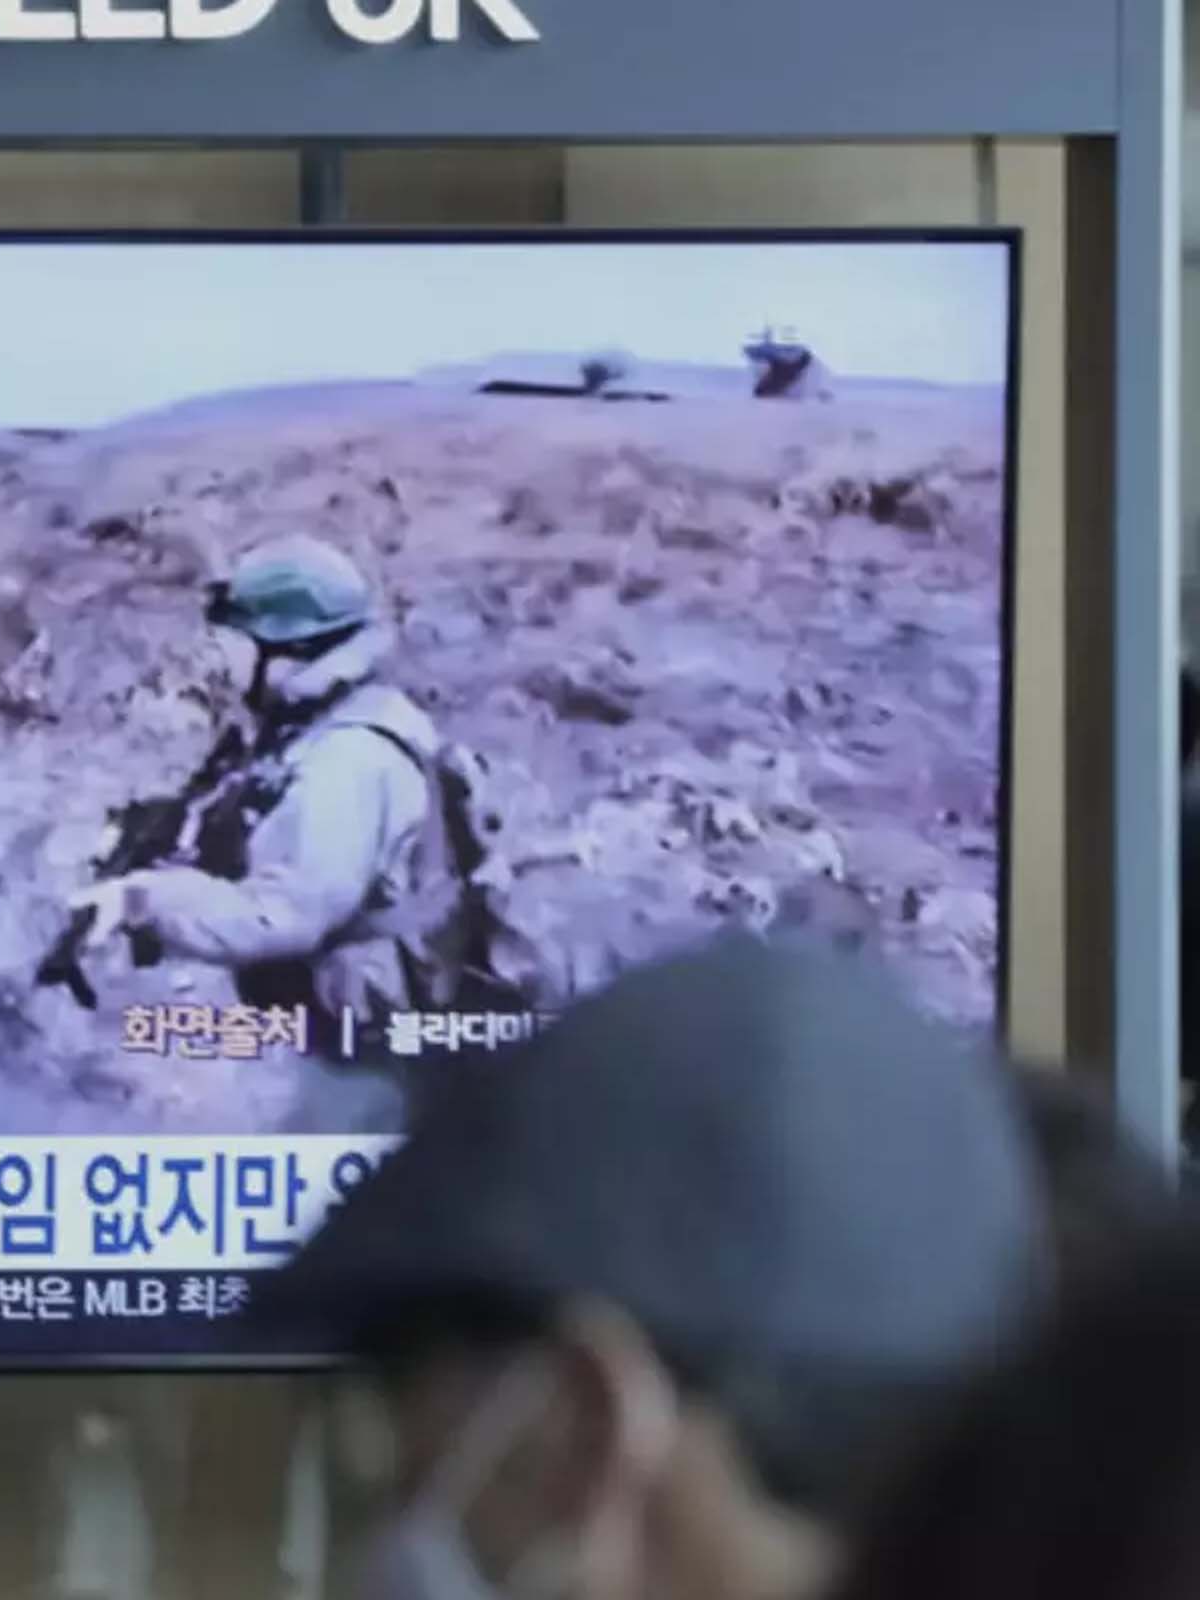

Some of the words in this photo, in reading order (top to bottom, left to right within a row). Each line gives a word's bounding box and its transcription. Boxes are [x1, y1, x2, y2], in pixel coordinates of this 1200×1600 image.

[121, 1003, 308, 1058] 화면출처
[385, 1011, 560, 1055] 블라디미
[84, 1152, 308, 1256] 없지만
[84, 1278, 168, 1317] MLB
